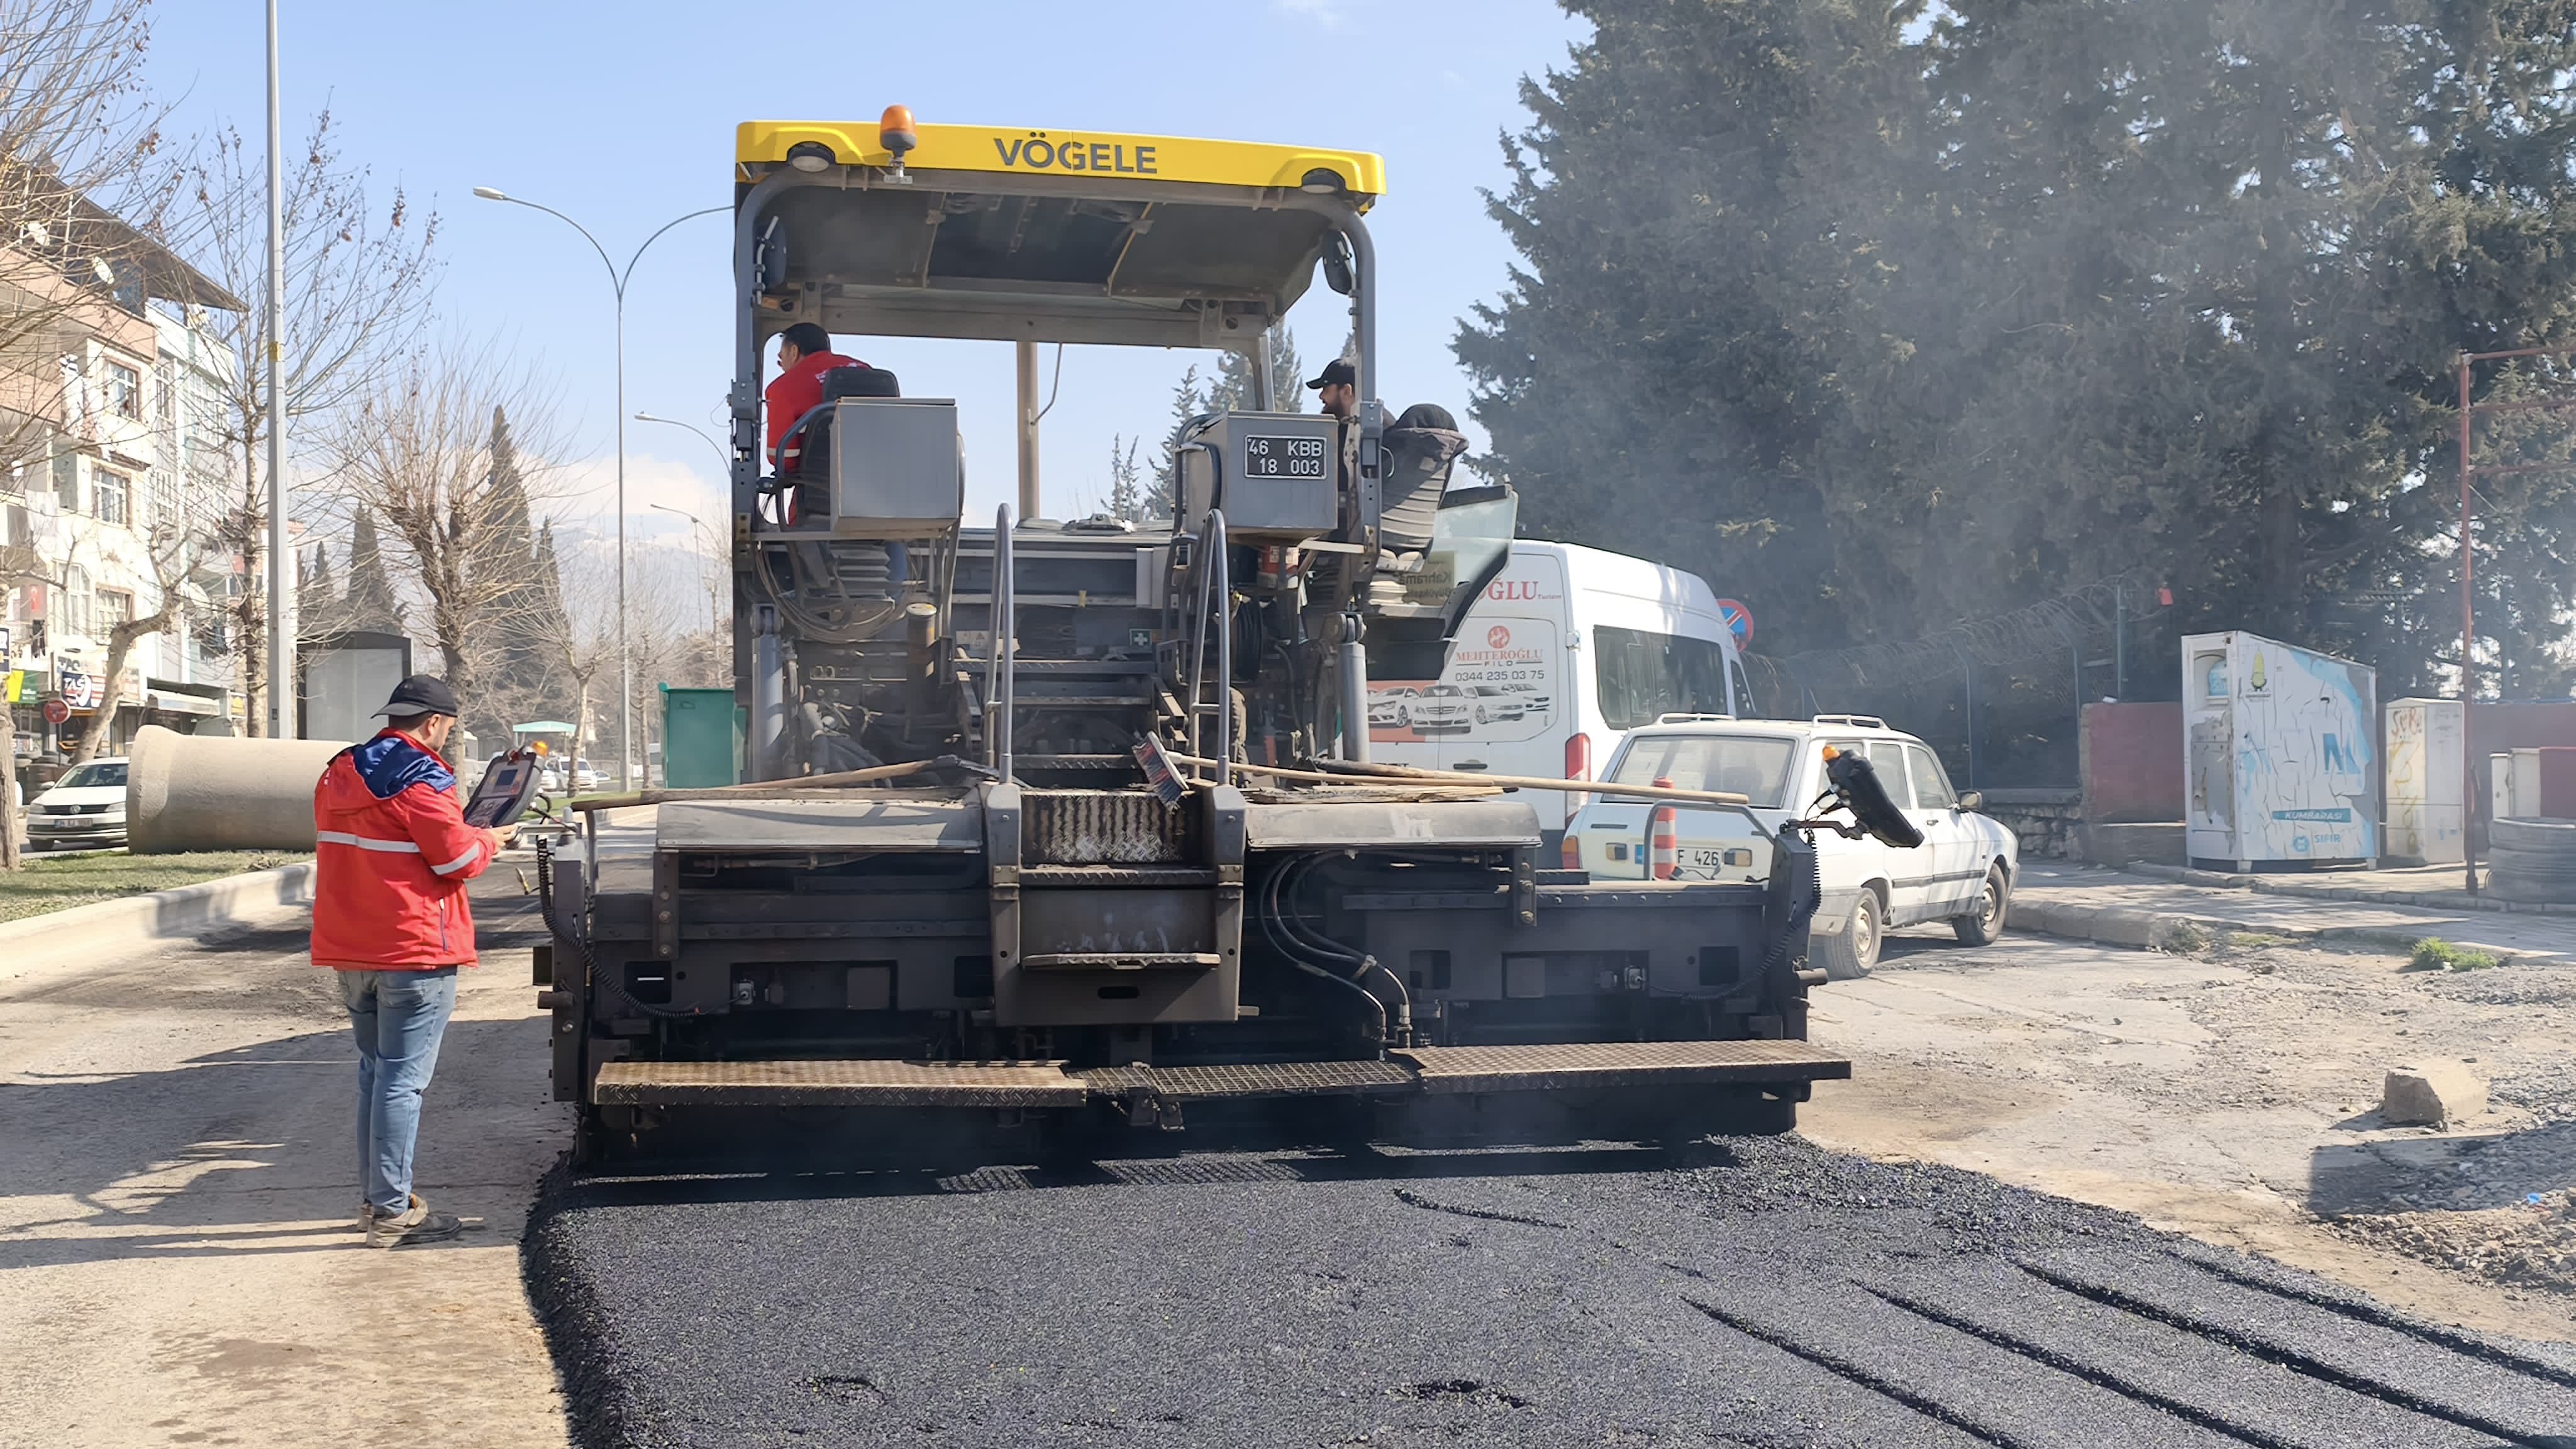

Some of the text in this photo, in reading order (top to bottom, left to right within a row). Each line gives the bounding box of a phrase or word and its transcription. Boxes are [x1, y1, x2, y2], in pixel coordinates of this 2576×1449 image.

[993, 131, 1157, 174] VÖGELE
[1248, 440, 1323, 457] 46 KBB
[1260, 457, 1319, 475] 18 003
[1456, 647, 1543, 662] MEHTEROĞLU
[1455, 670, 1545, 682] 0344 235 03 75
[1695, 850, 1719, 866] 426
